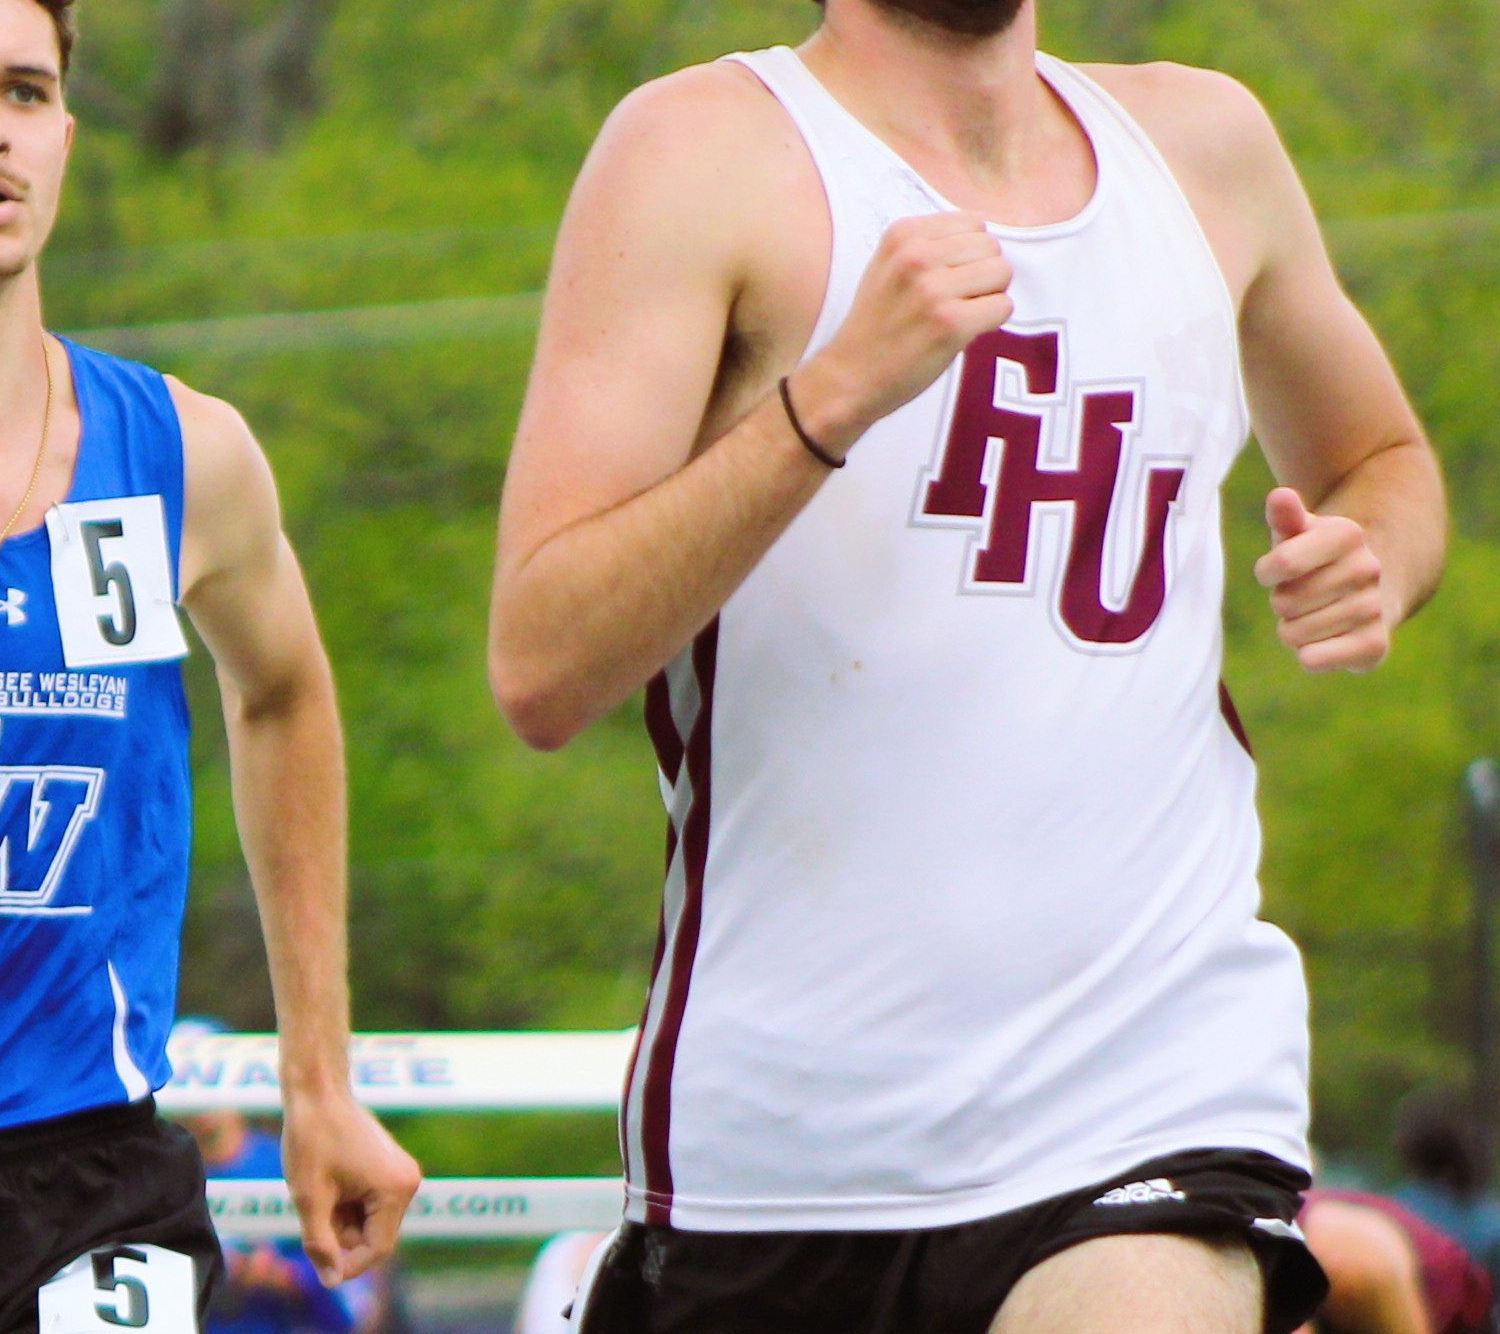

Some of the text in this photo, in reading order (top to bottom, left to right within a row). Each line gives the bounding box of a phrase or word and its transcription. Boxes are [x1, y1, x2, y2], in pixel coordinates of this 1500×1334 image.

[909, 318, 1192, 656] FHU
[80, 517, 136, 645] 5
[40, 673, 126, 694] WESLEYAN
[171, 1057, 453, 1086] WAEE
[91, 1247, 149, 1328] 5
